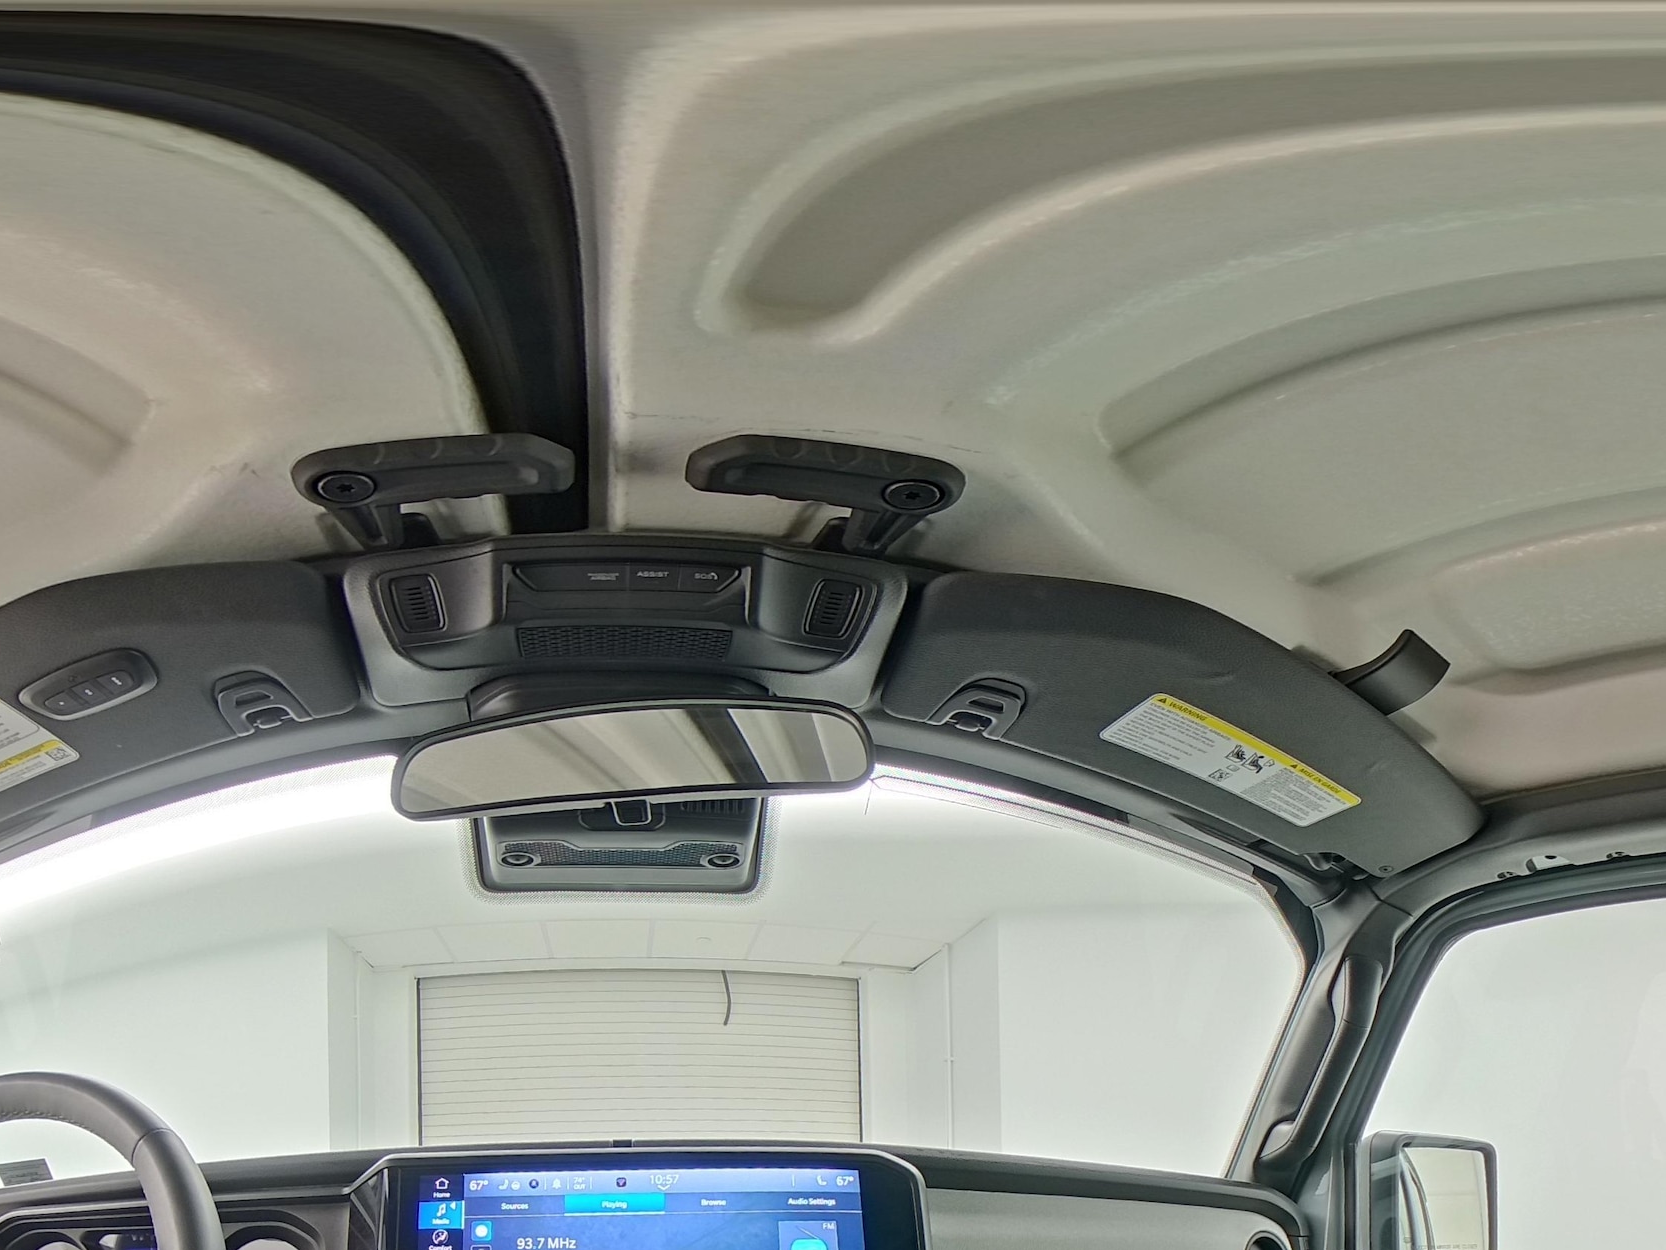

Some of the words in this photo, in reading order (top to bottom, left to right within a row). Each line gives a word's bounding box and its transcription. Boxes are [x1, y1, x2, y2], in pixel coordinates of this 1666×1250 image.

[1169, 701, 1208, 721] WARNING
[649, 1174, 679, 1185] 10:57
[836, 1175, 854, 1186] 67°
[469, 1179, 489, 1191] 67°
[433, 1190, 451, 1198] Home
[602, 1201, 628, 1209] Playing
[701, 1198, 726, 1206] Browse
[788, 1197, 808, 1206] Audio
[809, 1197, 836, 1207] Settings
[822, 1222, 835, 1230] FM
[516, 1237, 545, 1250] 93.7
[547, 1237, 577, 1249] MHz
